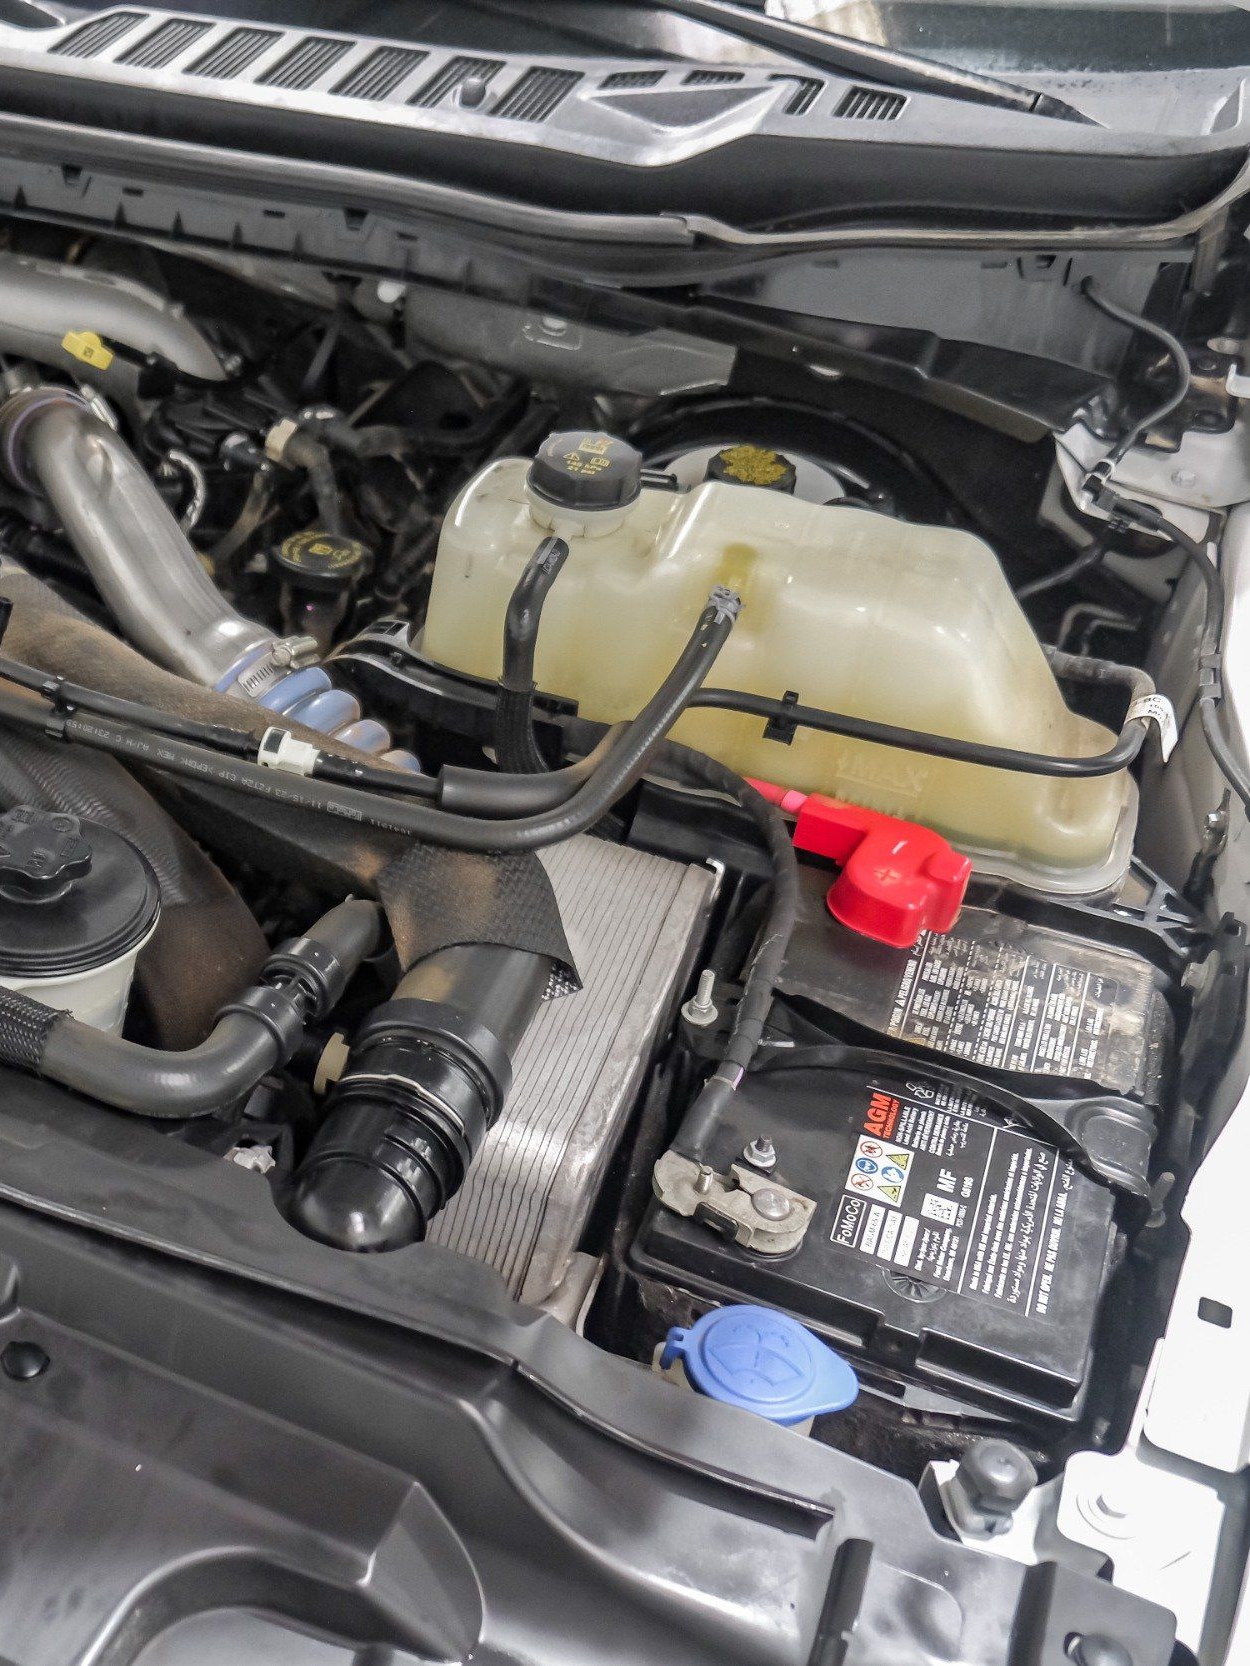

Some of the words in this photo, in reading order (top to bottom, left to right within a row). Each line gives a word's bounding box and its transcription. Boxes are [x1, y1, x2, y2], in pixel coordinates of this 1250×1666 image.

[862, 1091, 891, 1137] AGM
[882, 1098, 900, 1140] TECHNOLOGY
[935, 1167, 958, 1194] MF
[836, 1196, 861, 1245] FoMoCo
[1055, 1207, 1065, 1219] LA
[1044, 1260, 1055, 1272] NE
[1046, 1248, 1057, 1263] PAS
[1035, 1301, 1046, 1314] DO
